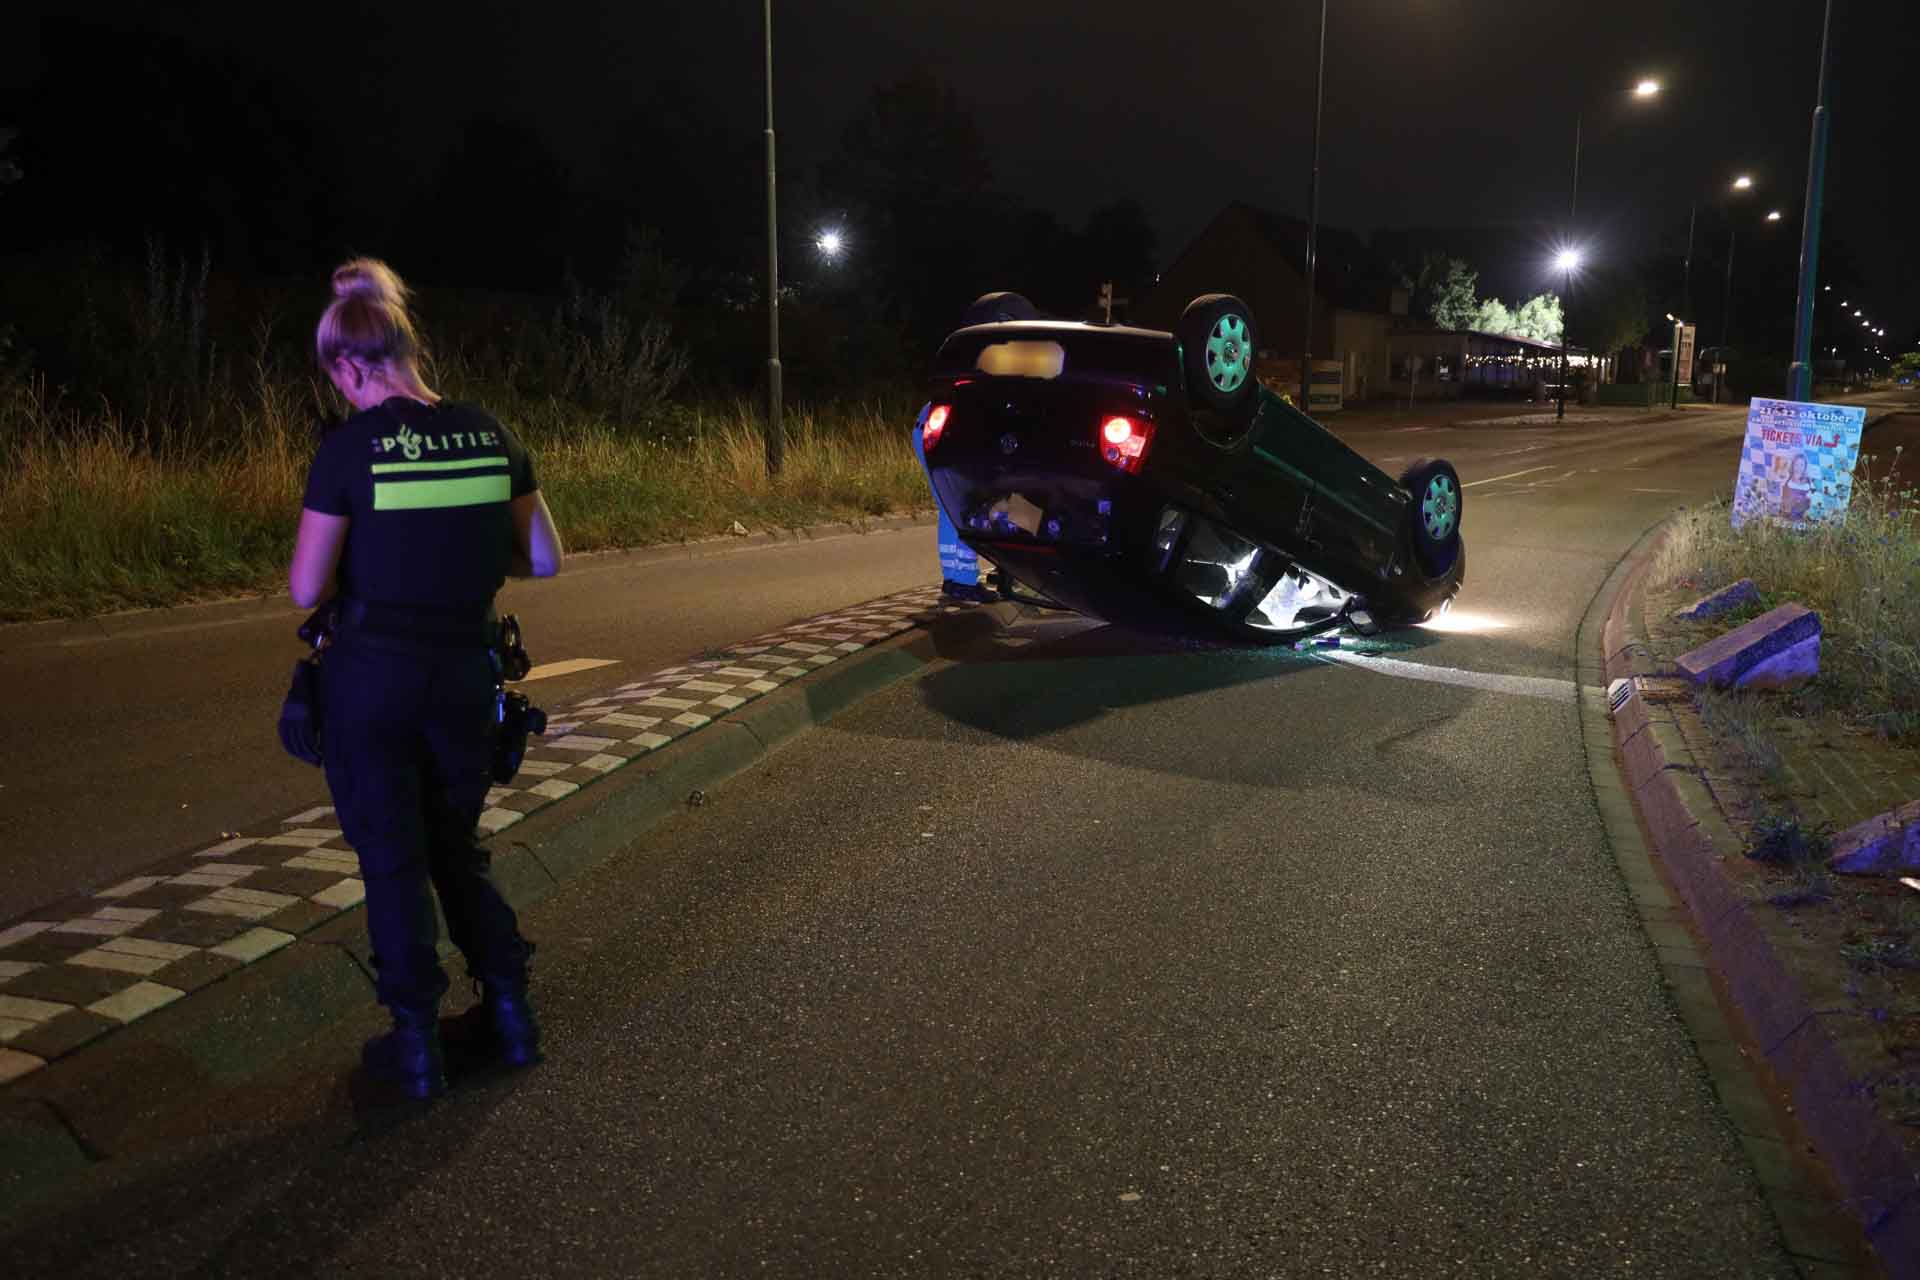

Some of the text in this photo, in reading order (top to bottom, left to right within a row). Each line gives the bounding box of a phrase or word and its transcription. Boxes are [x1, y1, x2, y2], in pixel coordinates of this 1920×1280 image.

[1799, 410, 1852, 422] oktober
[381, 428, 493, 460] POLITIE
[1761, 428, 1822, 447] TICKETS VIA
